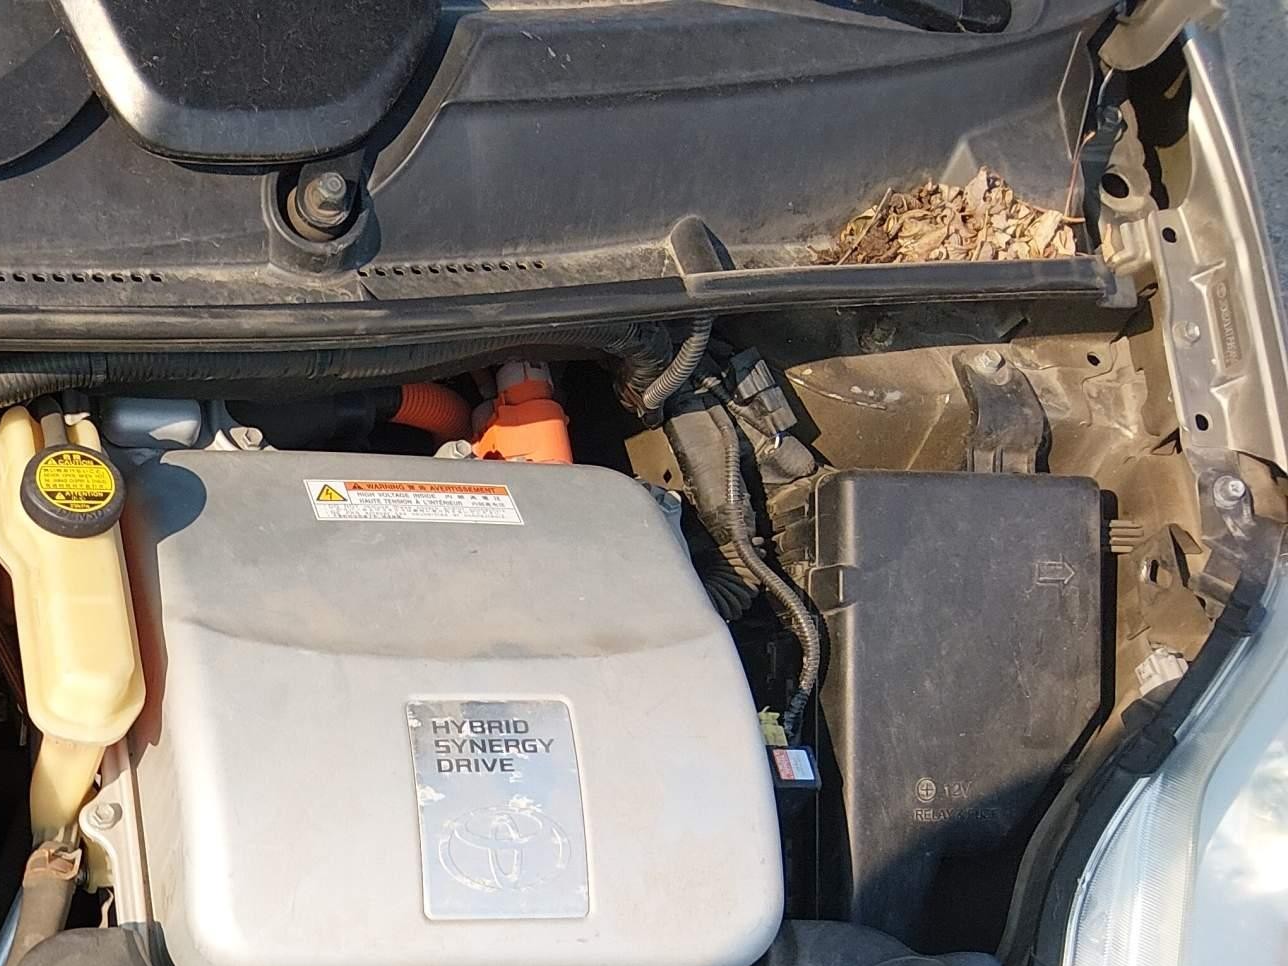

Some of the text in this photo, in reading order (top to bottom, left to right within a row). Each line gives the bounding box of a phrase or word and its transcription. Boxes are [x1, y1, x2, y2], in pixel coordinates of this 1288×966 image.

[430, 485, 495, 493] AVERTISSEMENT
[432, 719, 529, 734] HYBRID
[434, 738, 554, 754] SYNERGY
[437, 758, 515, 773] DRIVE
[943, 781, 971, 798] 12V
[914, 808, 954, 820] RELAY
